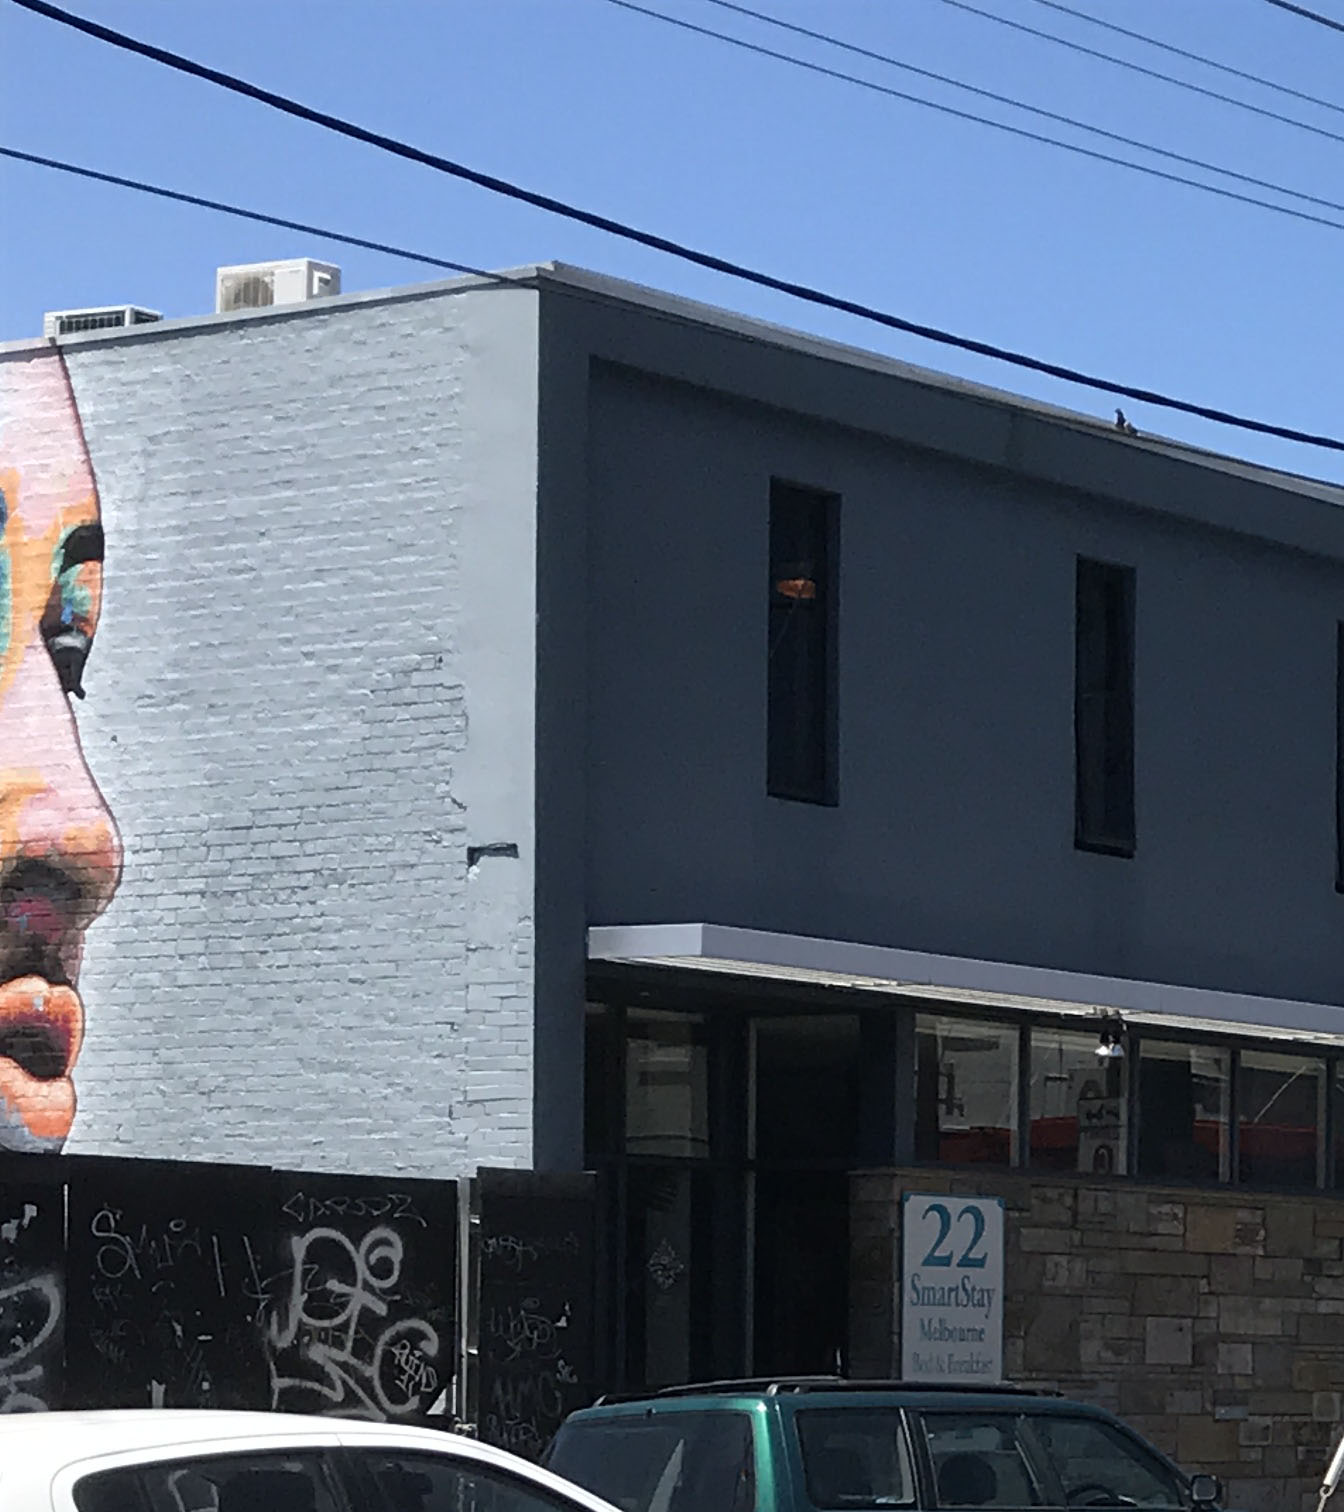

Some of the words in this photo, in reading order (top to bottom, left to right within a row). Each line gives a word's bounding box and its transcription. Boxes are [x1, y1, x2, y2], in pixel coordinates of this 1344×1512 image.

[920, 1203, 989, 1269] 22
[910, 1272, 997, 1320] SmartStay
[919, 1317, 986, 1343] Melbourne
